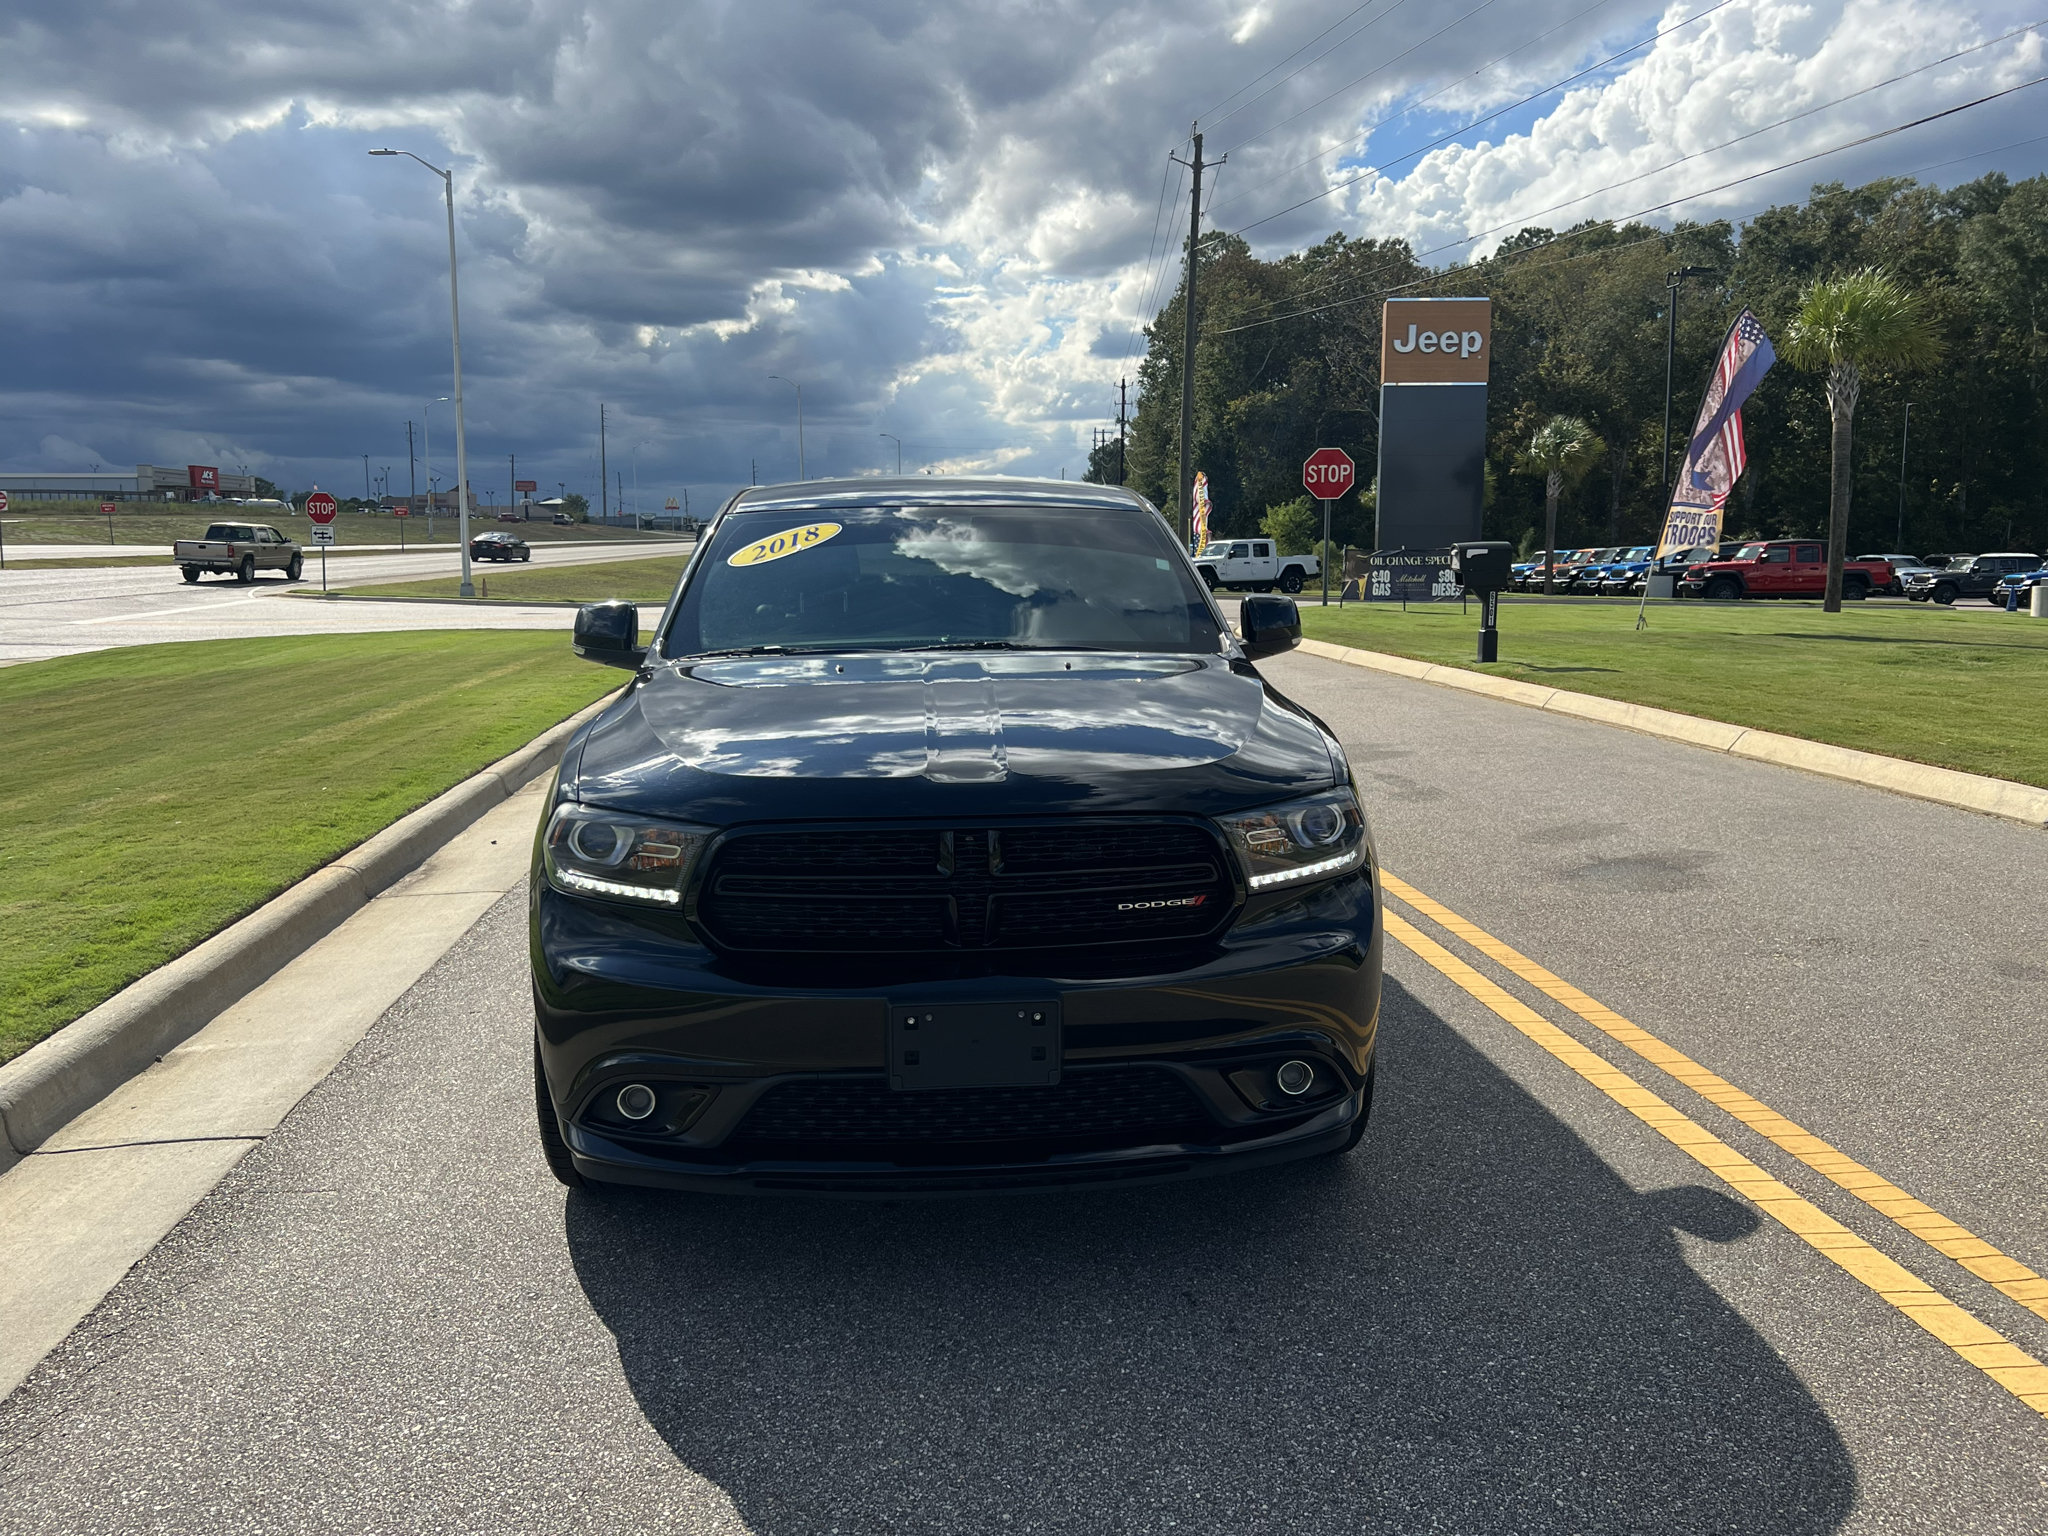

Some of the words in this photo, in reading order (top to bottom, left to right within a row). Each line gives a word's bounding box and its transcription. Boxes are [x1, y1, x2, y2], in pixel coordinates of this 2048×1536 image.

[1393, 324, 1483, 358] Jeep
[202, 470, 213, 479] ACE
[1307, 464, 1351, 483] STOP
[308, 502, 335, 515] STOP
[1664, 523, 1716, 546] TROOPS
[752, 526, 820, 562] 2018
[1370, 556, 1385, 565] OIL
[1386, 556, 1423, 565] CHANGE
[1371, 569, 1391, 583] $40
[1438, 569, 1455, 582] $80
[1372, 583, 1391, 596] GAS
[1118, 899, 1196, 910] DODGE
